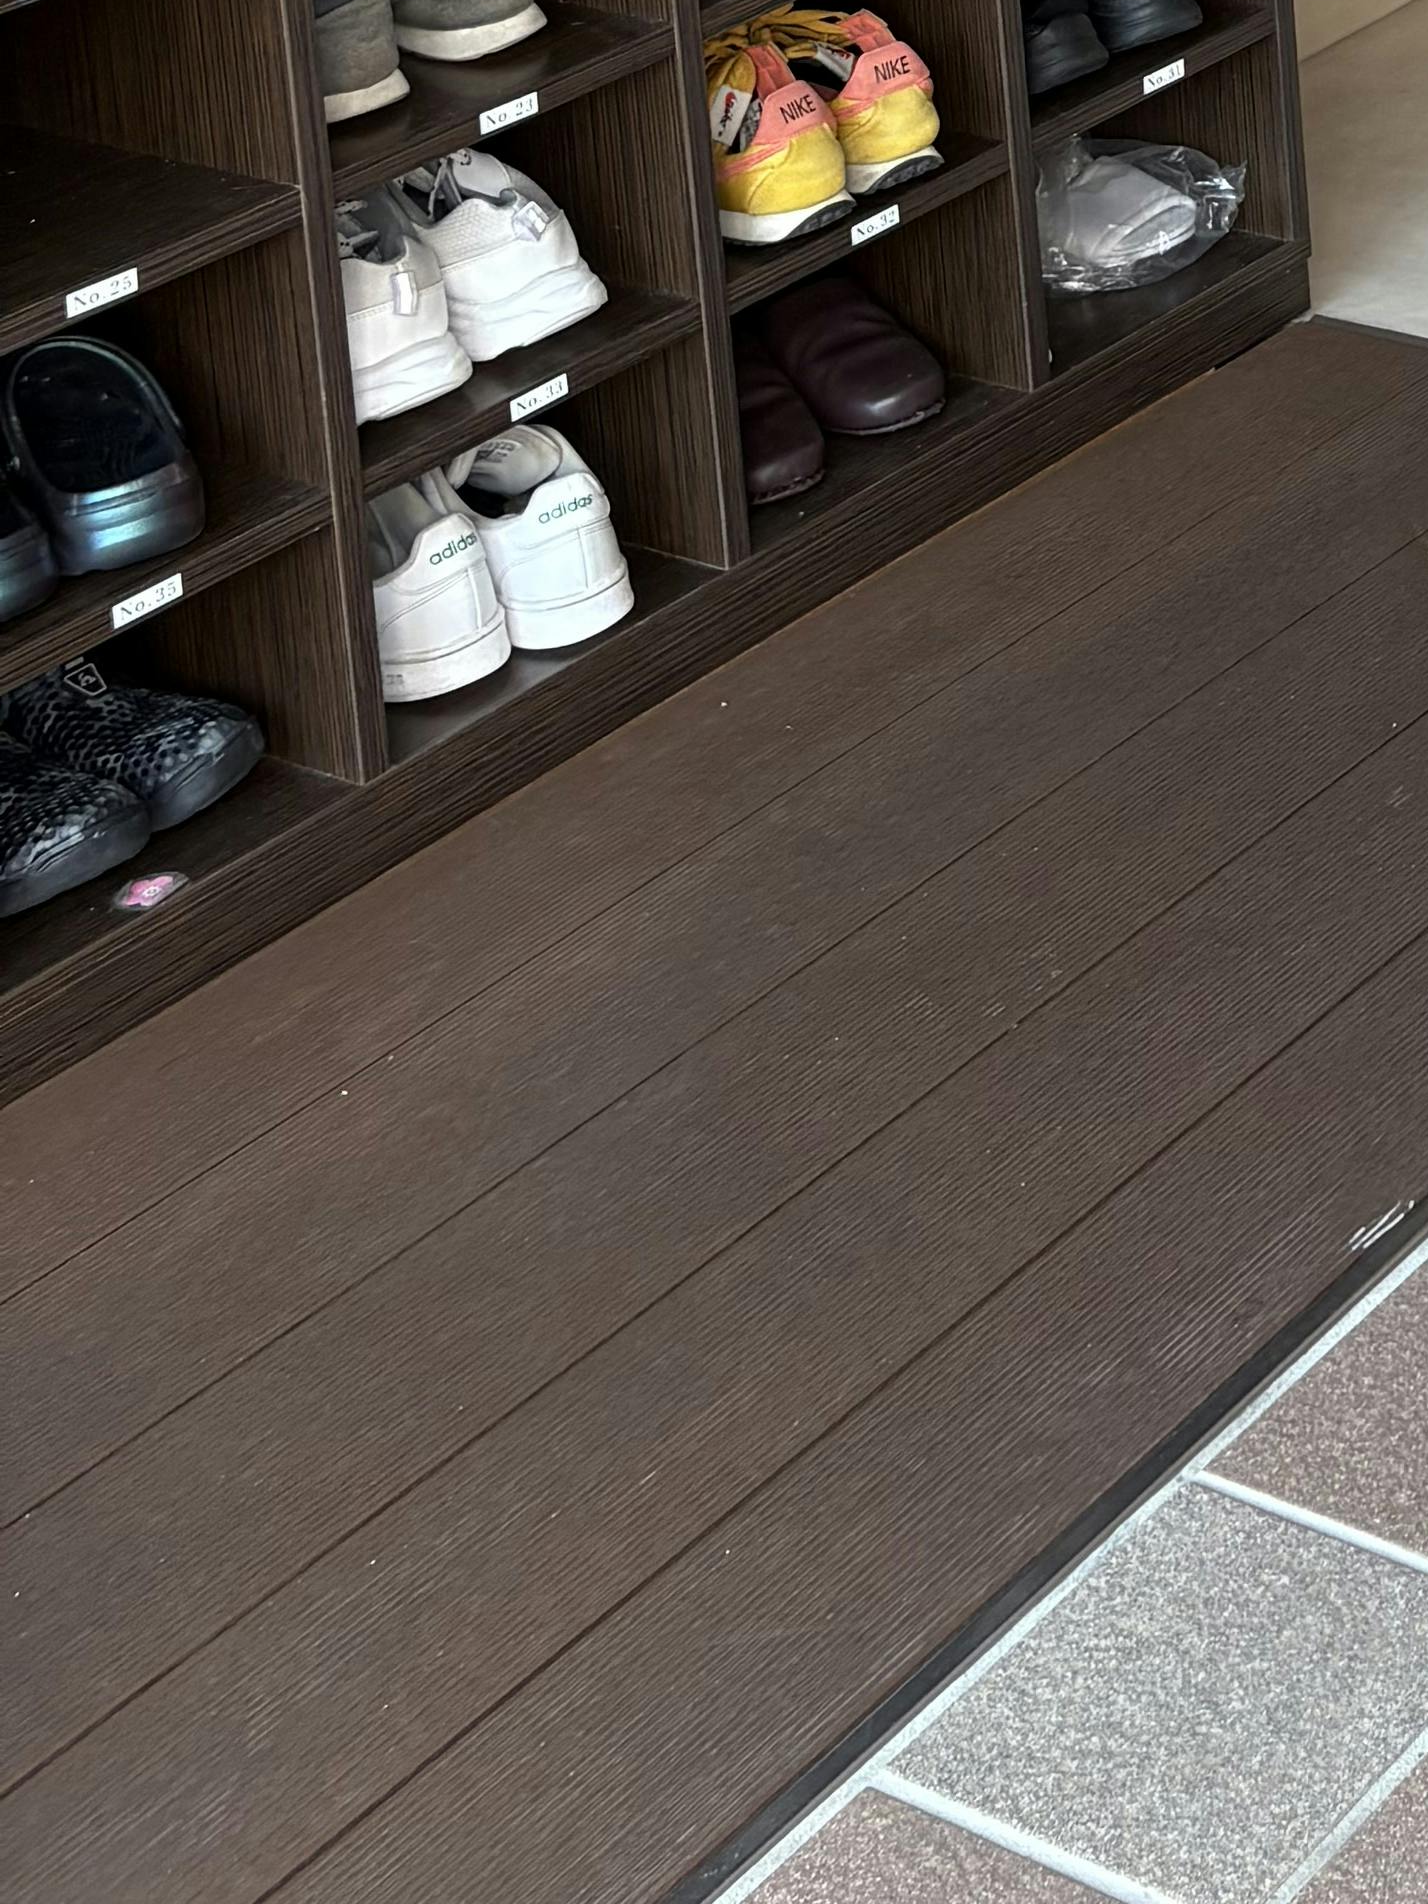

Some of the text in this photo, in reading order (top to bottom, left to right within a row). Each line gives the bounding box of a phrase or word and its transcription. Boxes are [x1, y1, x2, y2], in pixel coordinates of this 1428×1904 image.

[873, 55, 911, 84] NIKE
[1147, 64, 1181, 87] No.31
[485, 97, 533, 126] No.23
[779, 94, 816, 124] NIKE
[856, 210, 895, 236] No.32
[73, 275, 132, 306] No.25
[516, 380, 563, 410] No.33
[539, 494, 593, 525] adidas
[429, 532, 478, 566] adidas
[120, 581, 177, 616] No.35
